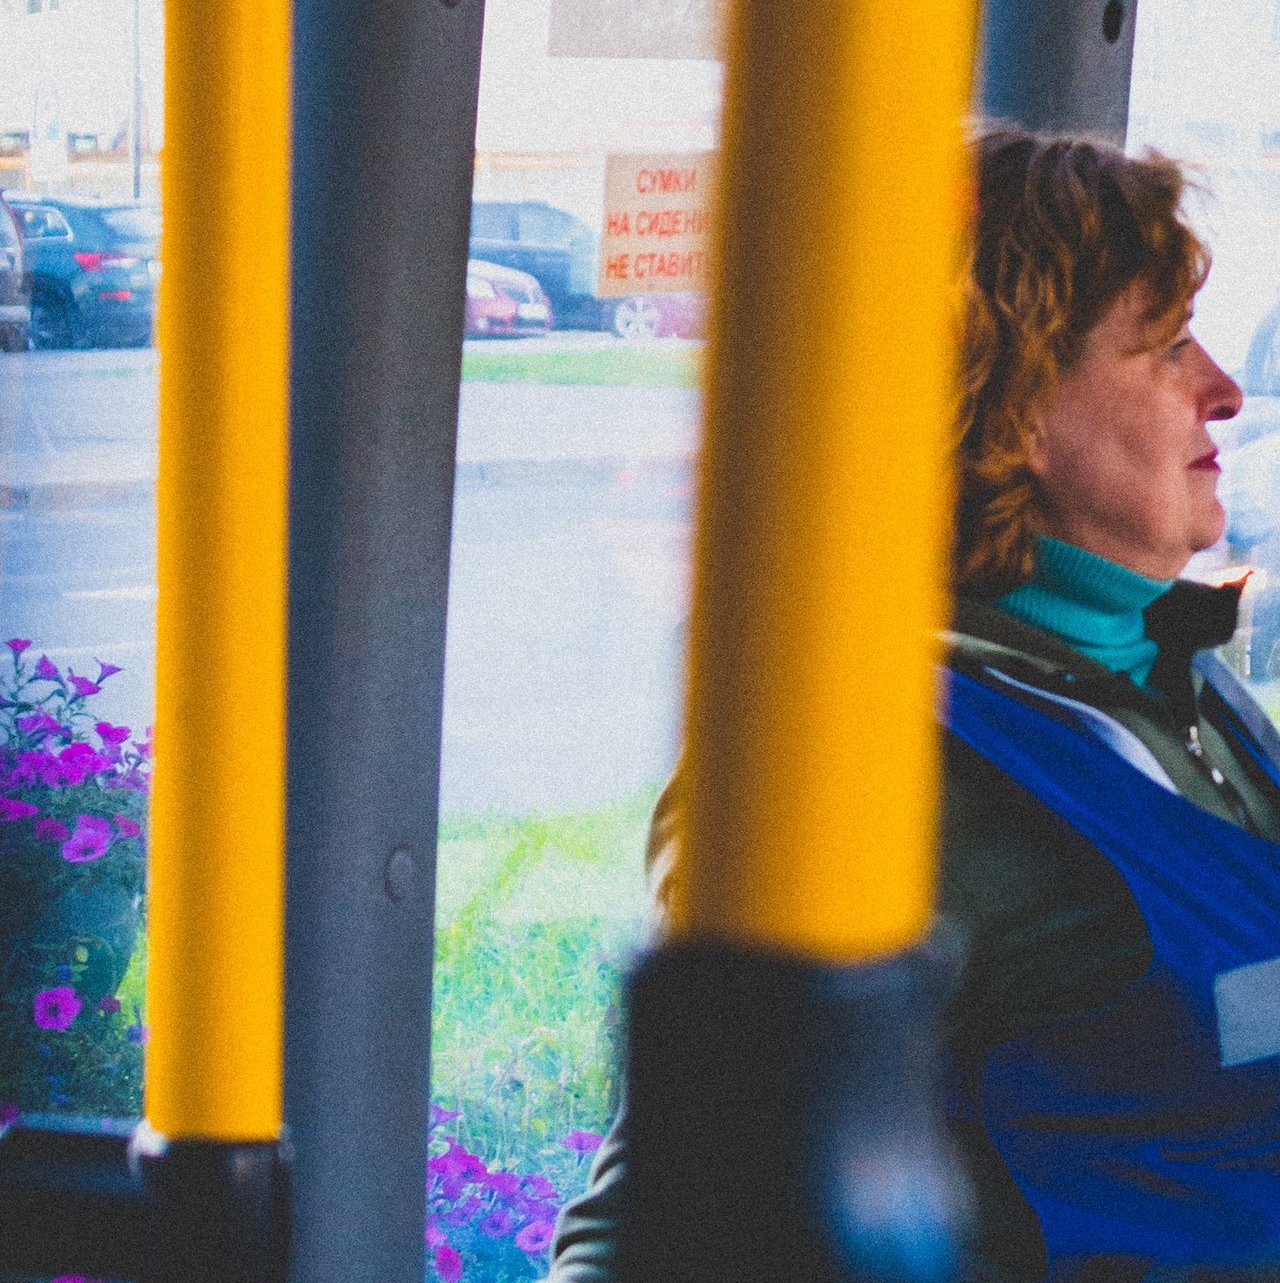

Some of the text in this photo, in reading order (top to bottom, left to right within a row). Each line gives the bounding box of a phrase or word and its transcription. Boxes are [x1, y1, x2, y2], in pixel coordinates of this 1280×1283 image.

[637, 168, 696, 194] СУМКИ
[606, 210, 708, 237] НА СИДЕНИ
[606, 251, 706, 279] НЕ СТАВИТ
